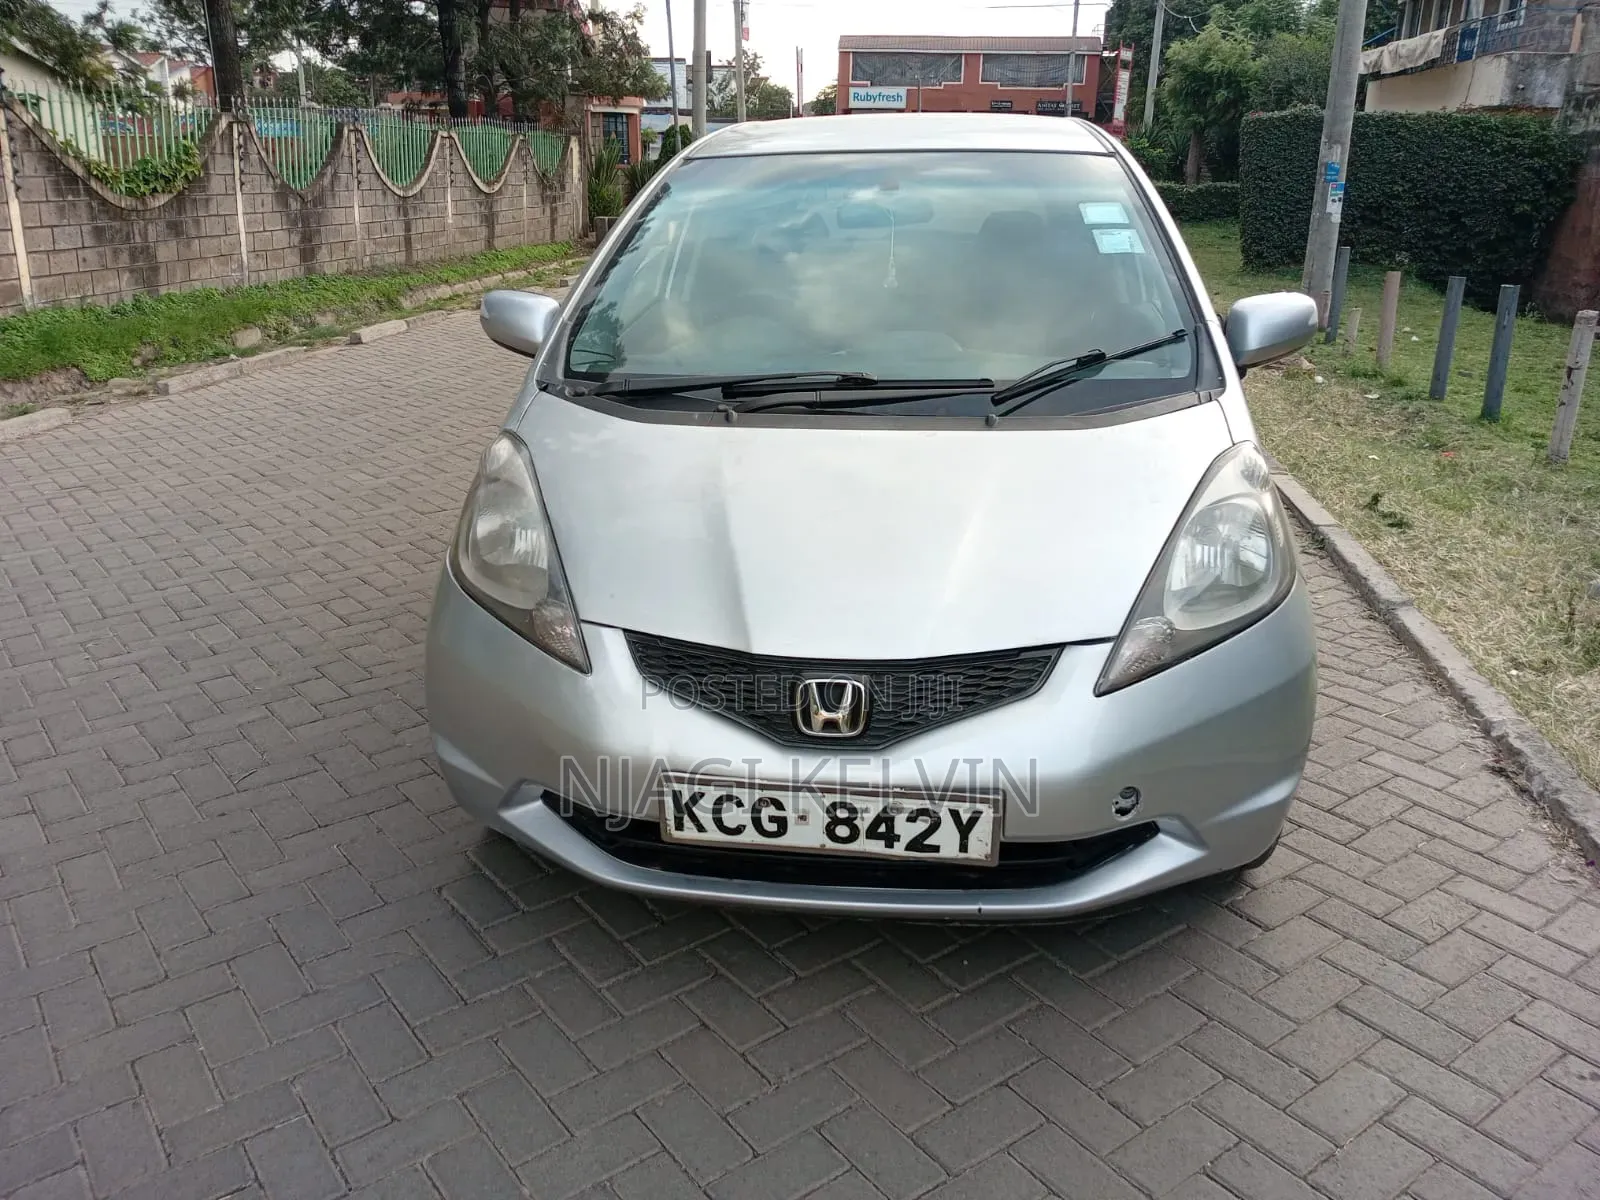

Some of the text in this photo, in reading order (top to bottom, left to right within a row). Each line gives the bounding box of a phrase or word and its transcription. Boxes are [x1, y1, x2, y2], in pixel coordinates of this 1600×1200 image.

[853, 92, 903, 103] Rubyfresh
[671, 789, 984, 854] KCG 842Y
